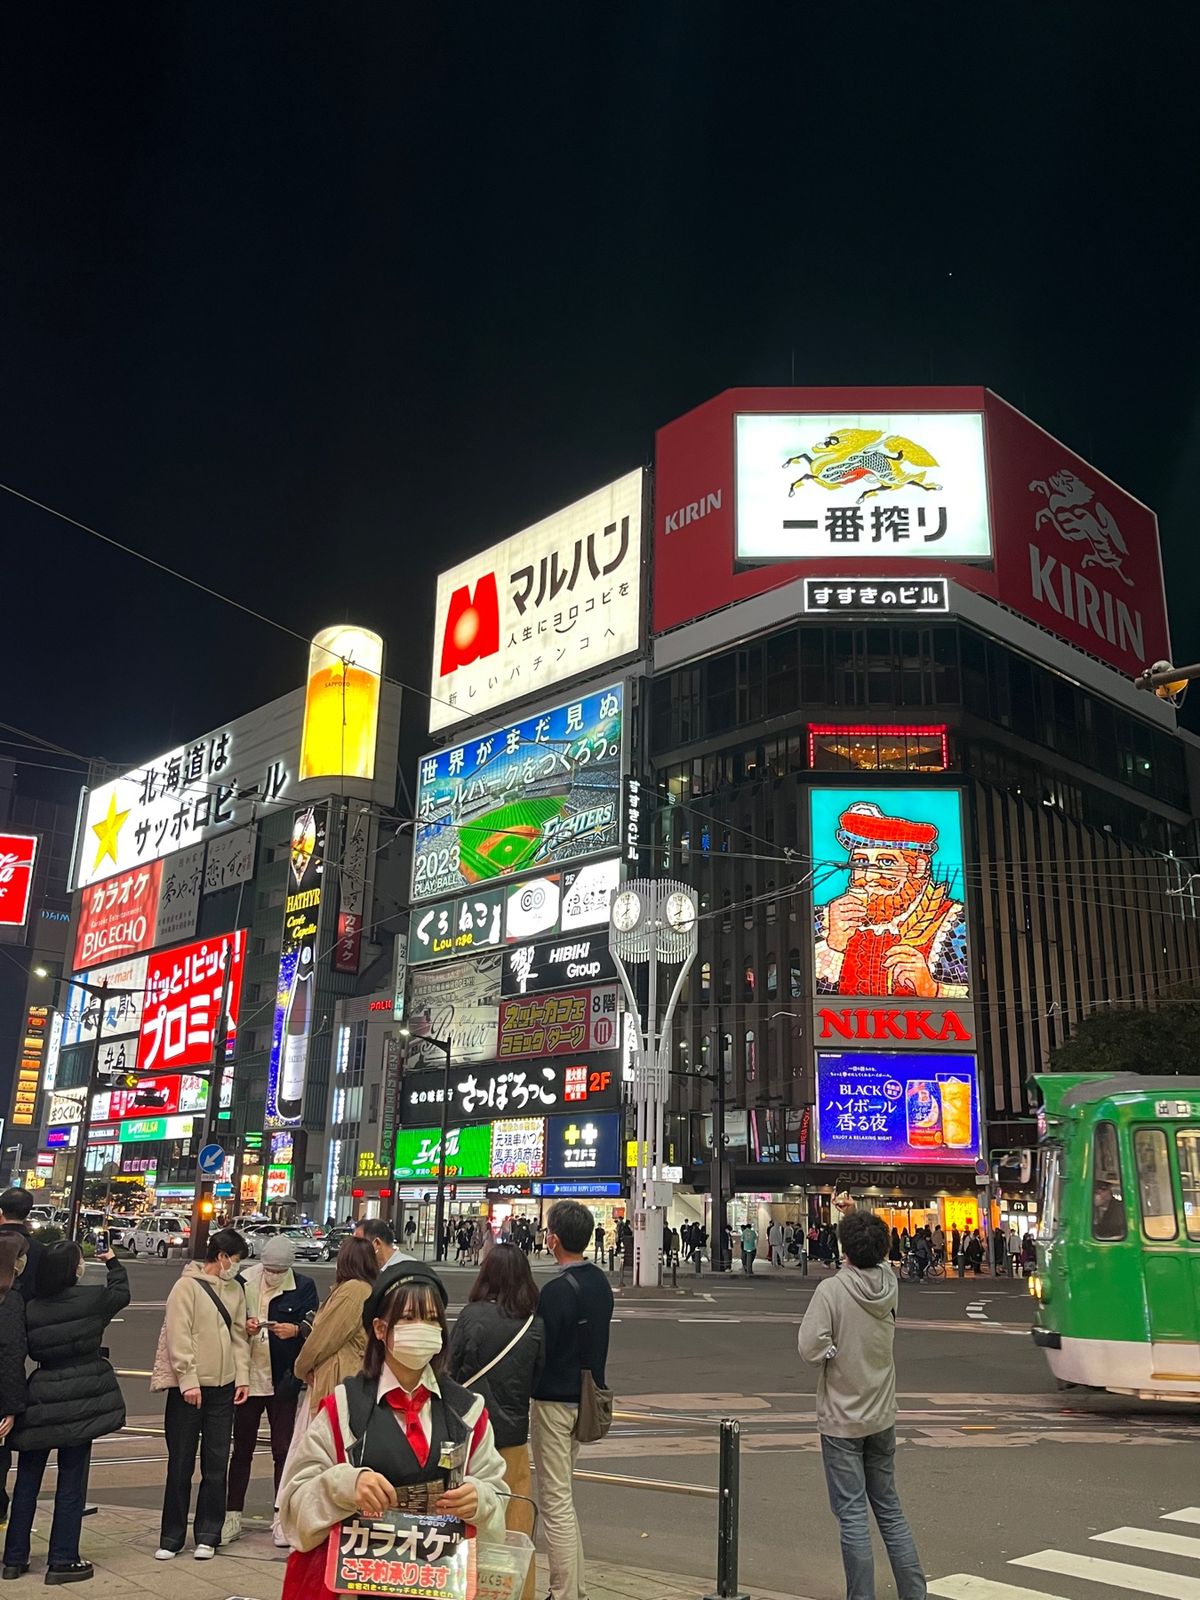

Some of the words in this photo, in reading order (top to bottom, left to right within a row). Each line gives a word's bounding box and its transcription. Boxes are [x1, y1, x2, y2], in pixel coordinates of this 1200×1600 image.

[665, 489, 722, 535] KIRIN
[783, 506, 947, 542] 一番搾り
[510, 515, 630, 616] マルハン
[814, 586, 938, 605] すすきのビル
[1029, 544, 1146, 663] KIRIN
[507, 583, 630, 648] 人生にヨロコビを
[449, 628, 615, 706] 新しいパチンコへ
[422, 693, 619, 786] 世界がまだ見ぬ
[139, 733, 230, 806] 北海道は
[419, 731, 618, 816] ボールパークをつくろう。
[134, 763, 287, 856] サッポロビール
[535, 803, 614, 863] FIGHTERS
[415, 845, 461, 881] 2023
[90, 873, 150, 914] カラオケ
[286, 888, 321, 913] HATHYR
[436, 874, 460, 892] BALL
[82, 928, 108, 959] BIG
[108, 915, 147, 945] ECHO
[342, 915, 356, 962] カラオケ
[416, 902, 488, 945] くろねこ
[433, 933, 473, 952] Lounge
[549, 942, 591, 963] HIBIKI
[567, 961, 600, 977] Group
[502, 997, 587, 1031] ネットカフェ
[592, 994, 616, 1013] 8階
[547, 1025, 585, 1051] ダーツ
[818, 1008, 972, 1041] NIKKA
[501, 1031, 545, 1056] コミック
[457, 1067, 557, 1113] さっぽろっこ
[589, 1071, 611, 1092] 2F
[840, 1084, 882, 1096] BLACK
[825, 1100, 897, 1114] ハイボール
[836, 1114, 888, 1132] 香る夜
[1159, 1103, 1187, 1115] 出口
[496, 1132, 537, 1147] 元祖串かつ
[340, 1520, 450, 1562] カラオケ
[341, 1558, 451, 1589] ご予約承ります
